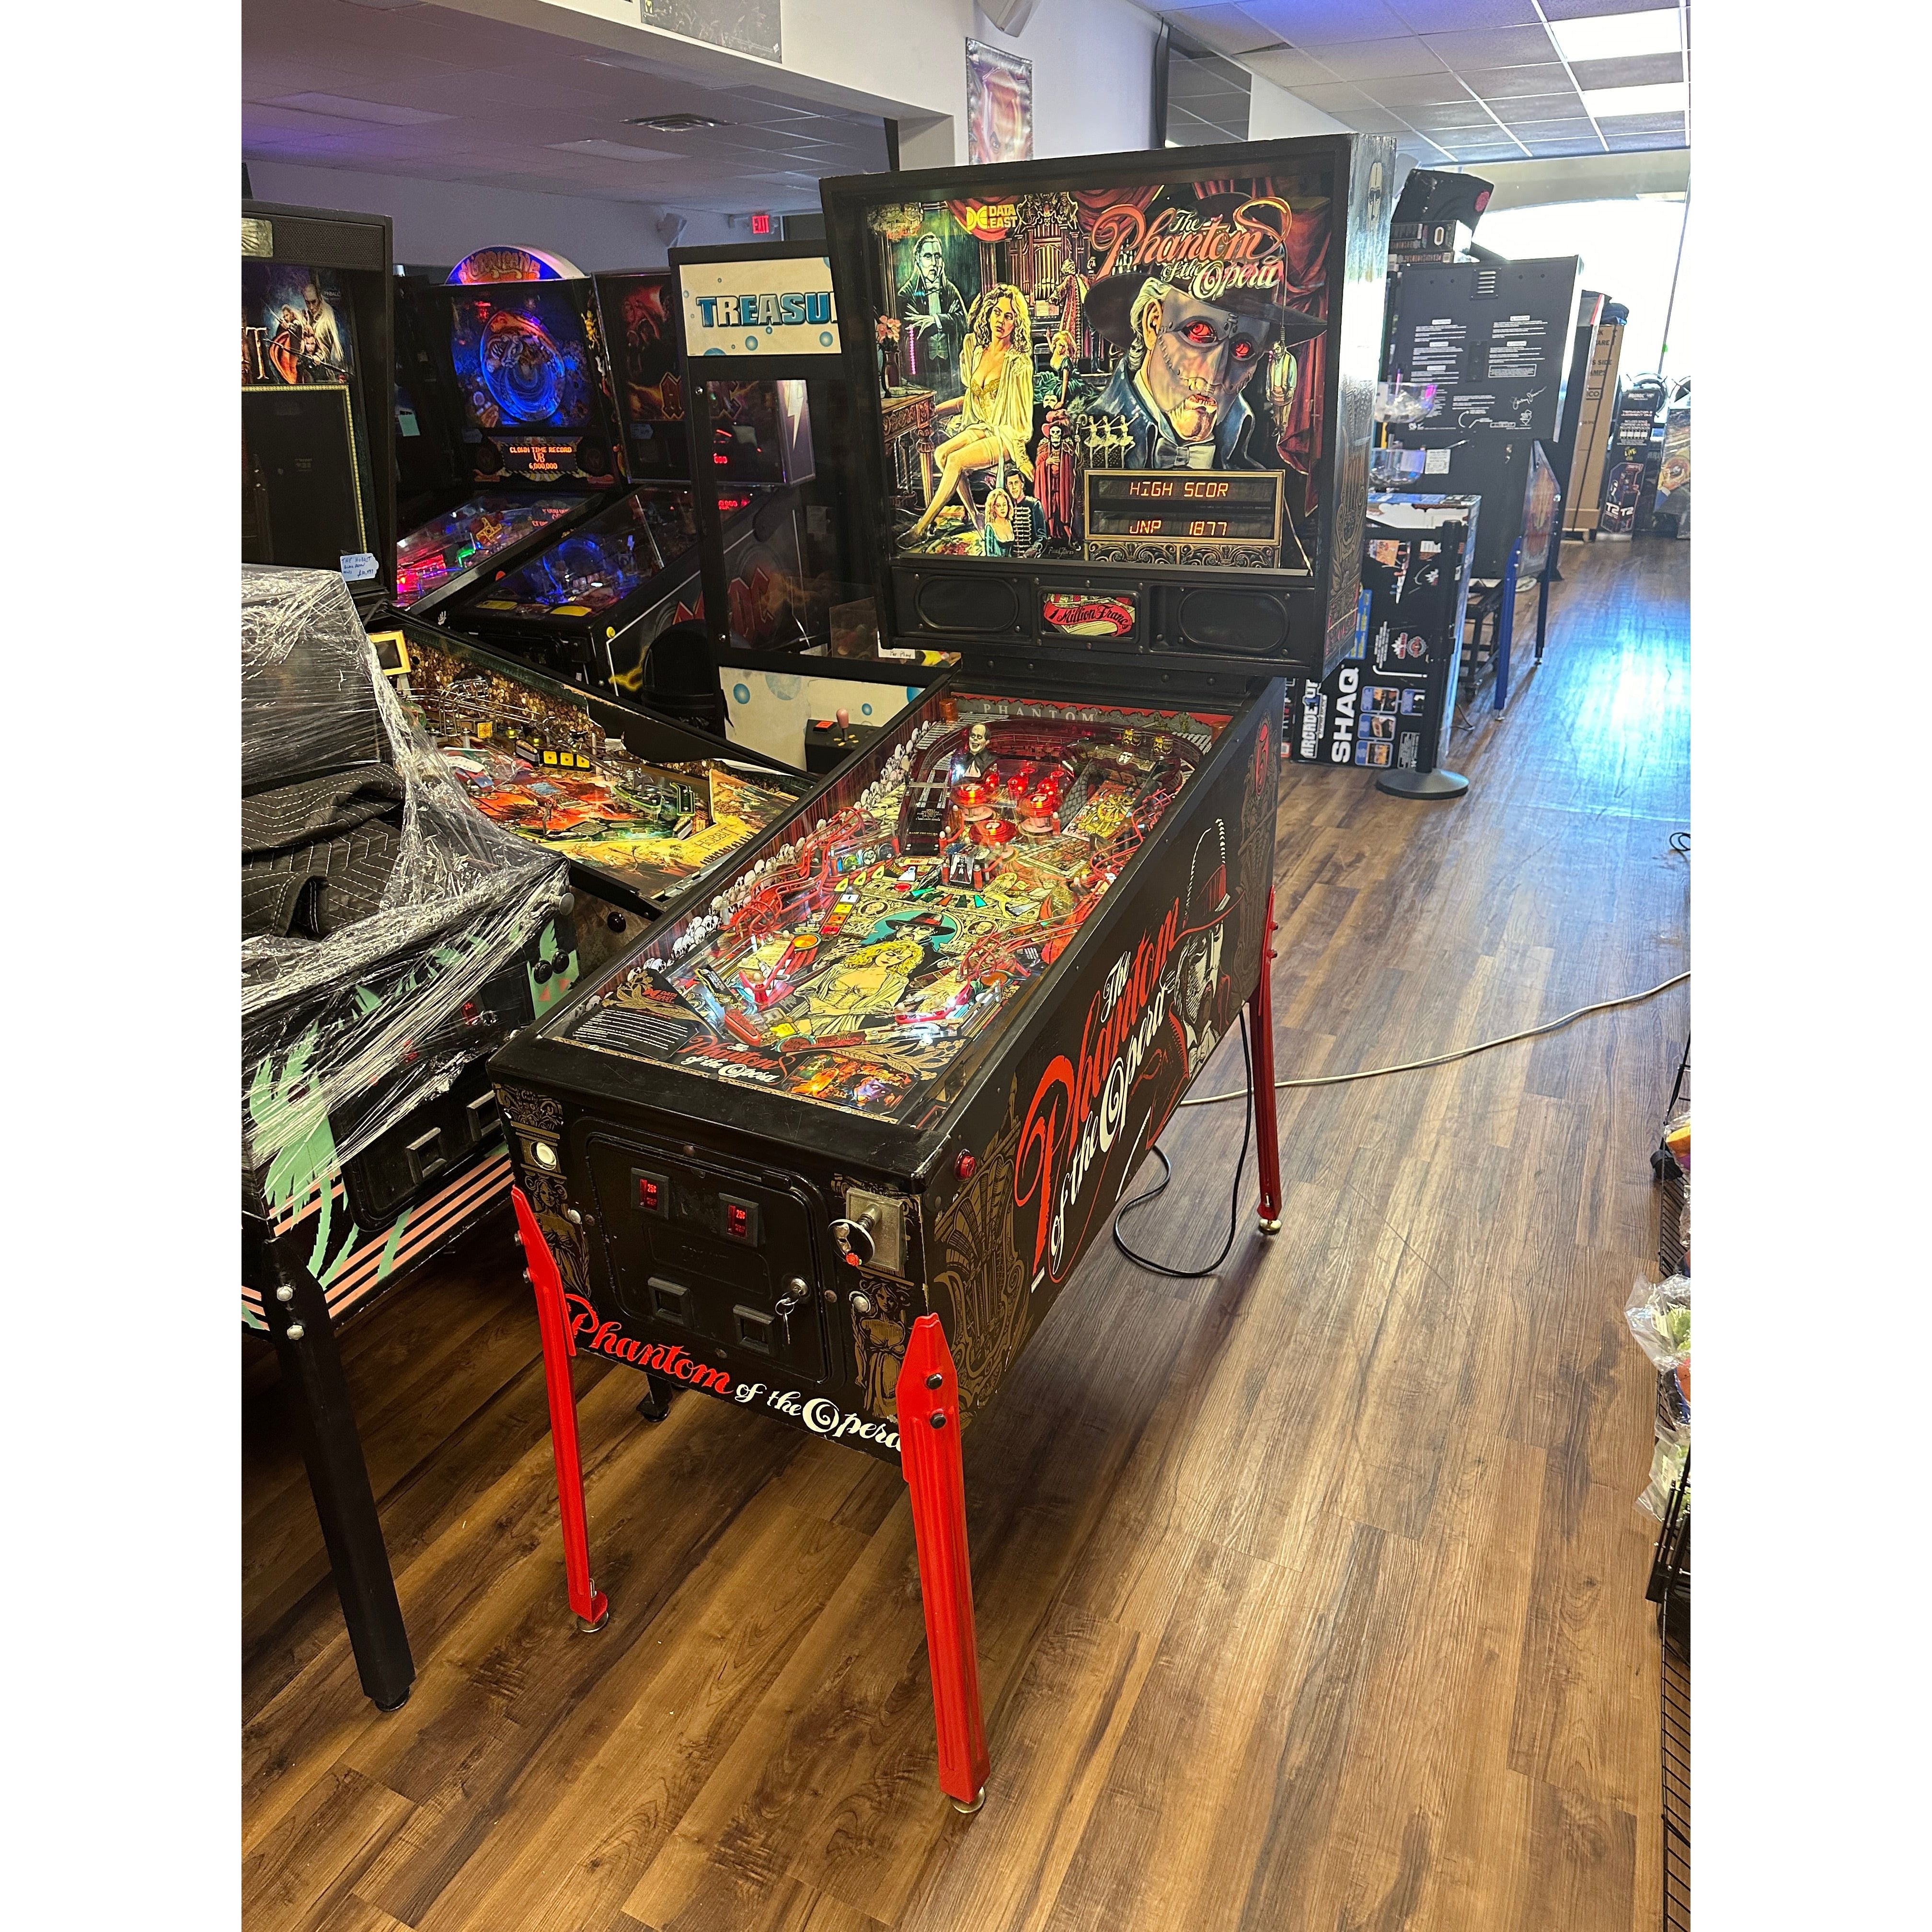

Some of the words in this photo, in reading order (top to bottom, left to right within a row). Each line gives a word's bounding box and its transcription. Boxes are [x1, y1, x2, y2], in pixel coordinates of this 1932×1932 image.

[989, 204, 1016, 217] DATA
[1169, 208, 1202, 232] The
[752, 215, 769, 233] EXIT
[990, 217, 1018, 229] EAST
[1090, 196, 1292, 280] Phantom
[1163, 263, 1181, 281] of
[1180, 258, 1201, 279] the
[1190, 255, 1280, 301] Opera
[696, 292, 837, 328] TREASU
[1130, 482, 1173, 497] HIGH
[1184, 483, 1229, 498] SCOR
[1606, 502, 1620, 516] T2
[1129, 520, 1162, 534] JNP
[1189, 521, 1228, 536] 1877
[1057, 606, 1096, 623] Million
[1095, 605, 1129, 630] Francs
[983, 704, 1095, 722] PHANTOM
[1331, 667, 1359, 763] SHAQ
[694, 827, 741, 851] HOBBIT
[1101, 951, 1131, 1023] The
[726, 1043, 749, 1052] The
[677, 1035, 796, 1085] Phantom
[700, 1057, 729, 1069] the
[718, 1063, 780, 1083] Opera
[1014, 897, 1180, 1277] Phantom
[1050, 1173, 1070, 1276] of
[1070, 1111, 1099, 1206] the
[1099, 976, 1174, 1154] Opera
[565, 1294, 734, 1394] Phantom
[735, 1383, 767, 1403] of
[767, 1392, 802, 1416] the
[803, 1398, 902, 1452] Opera
